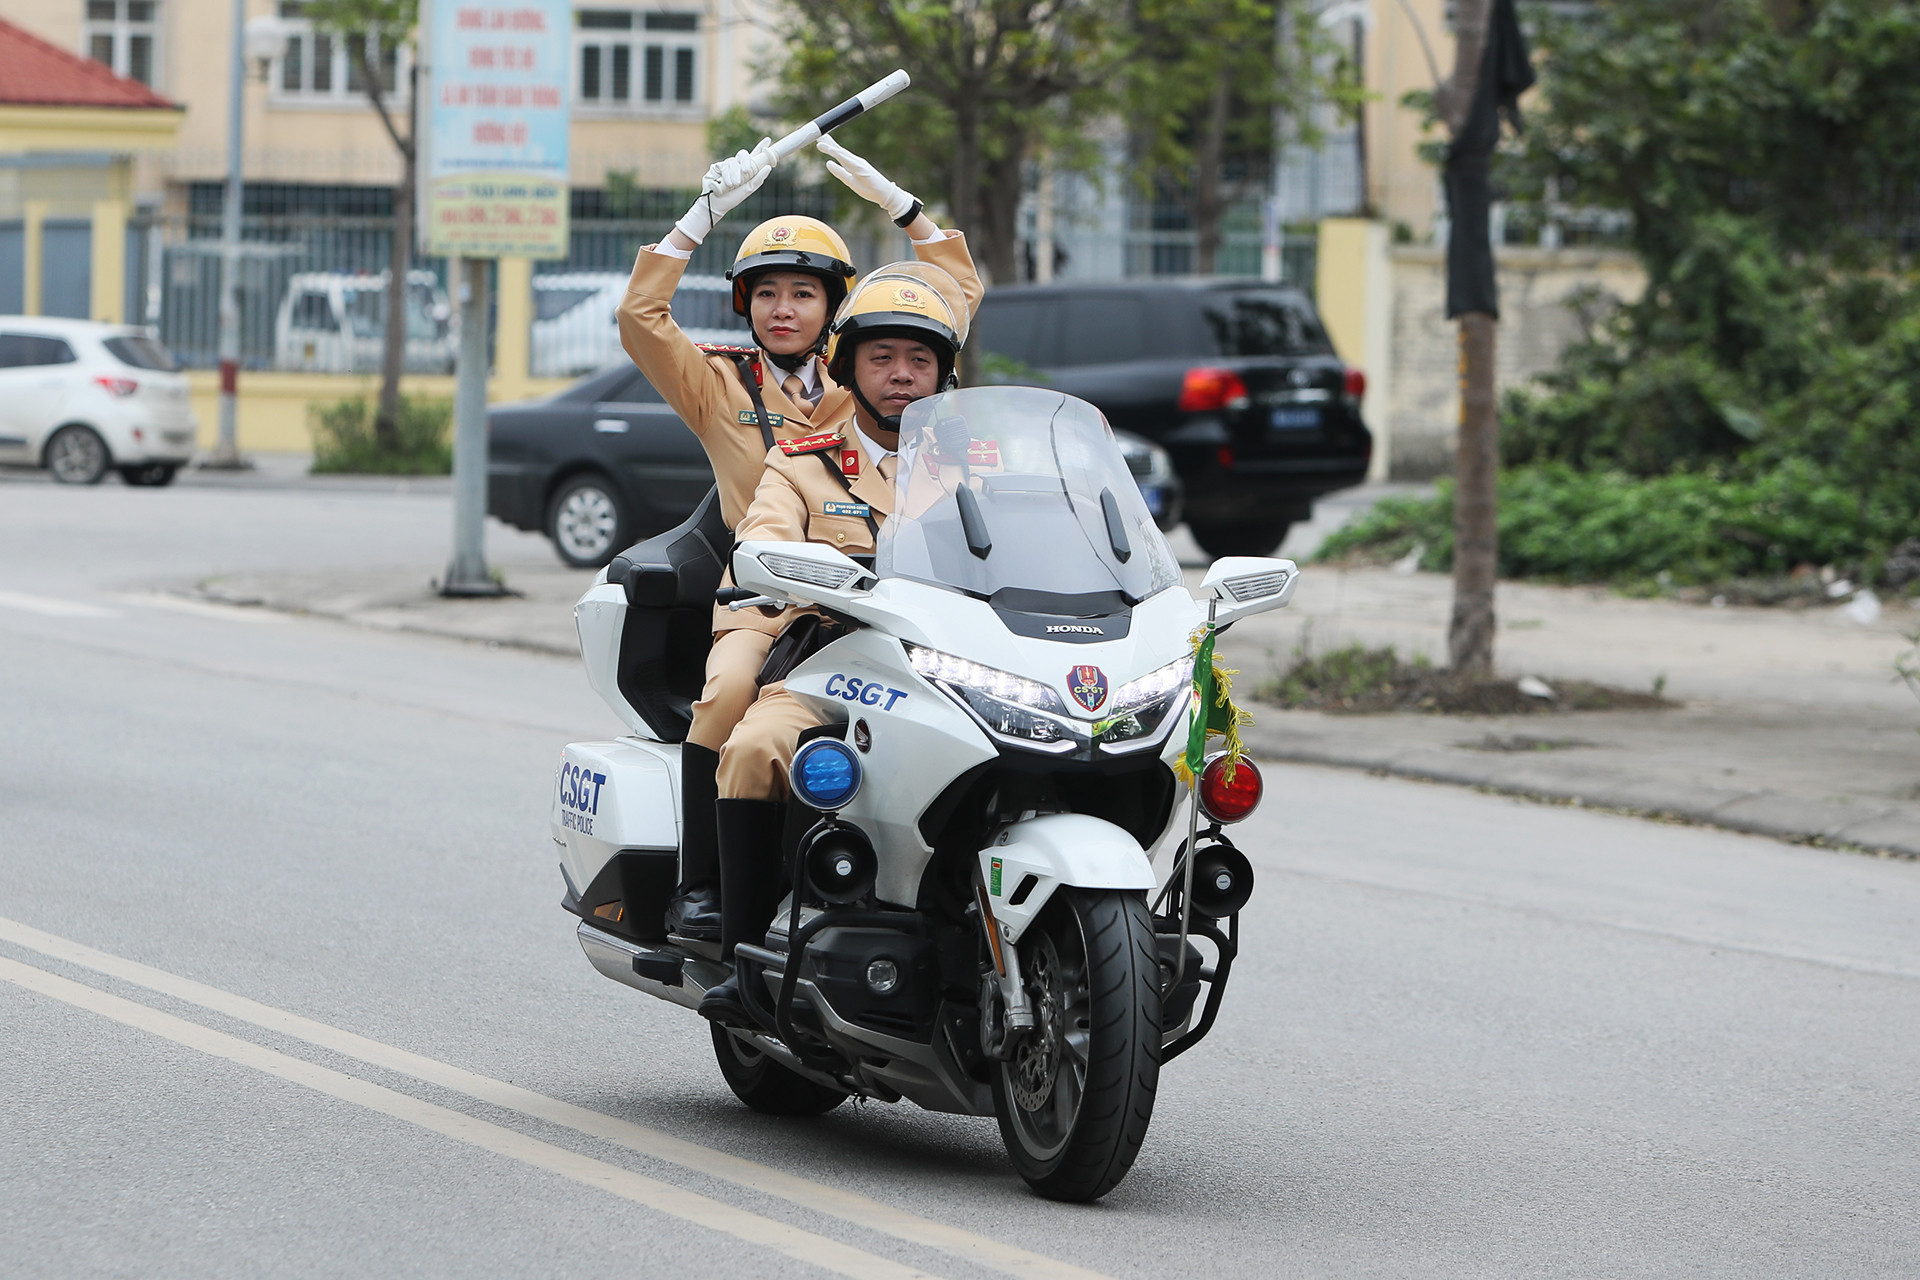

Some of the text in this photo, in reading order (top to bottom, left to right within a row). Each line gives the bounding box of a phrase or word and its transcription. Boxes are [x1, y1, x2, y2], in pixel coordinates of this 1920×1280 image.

[1046, 625, 1104, 635] HONDA
[562, 809, 593, 836] TRAFFIC POLICE
